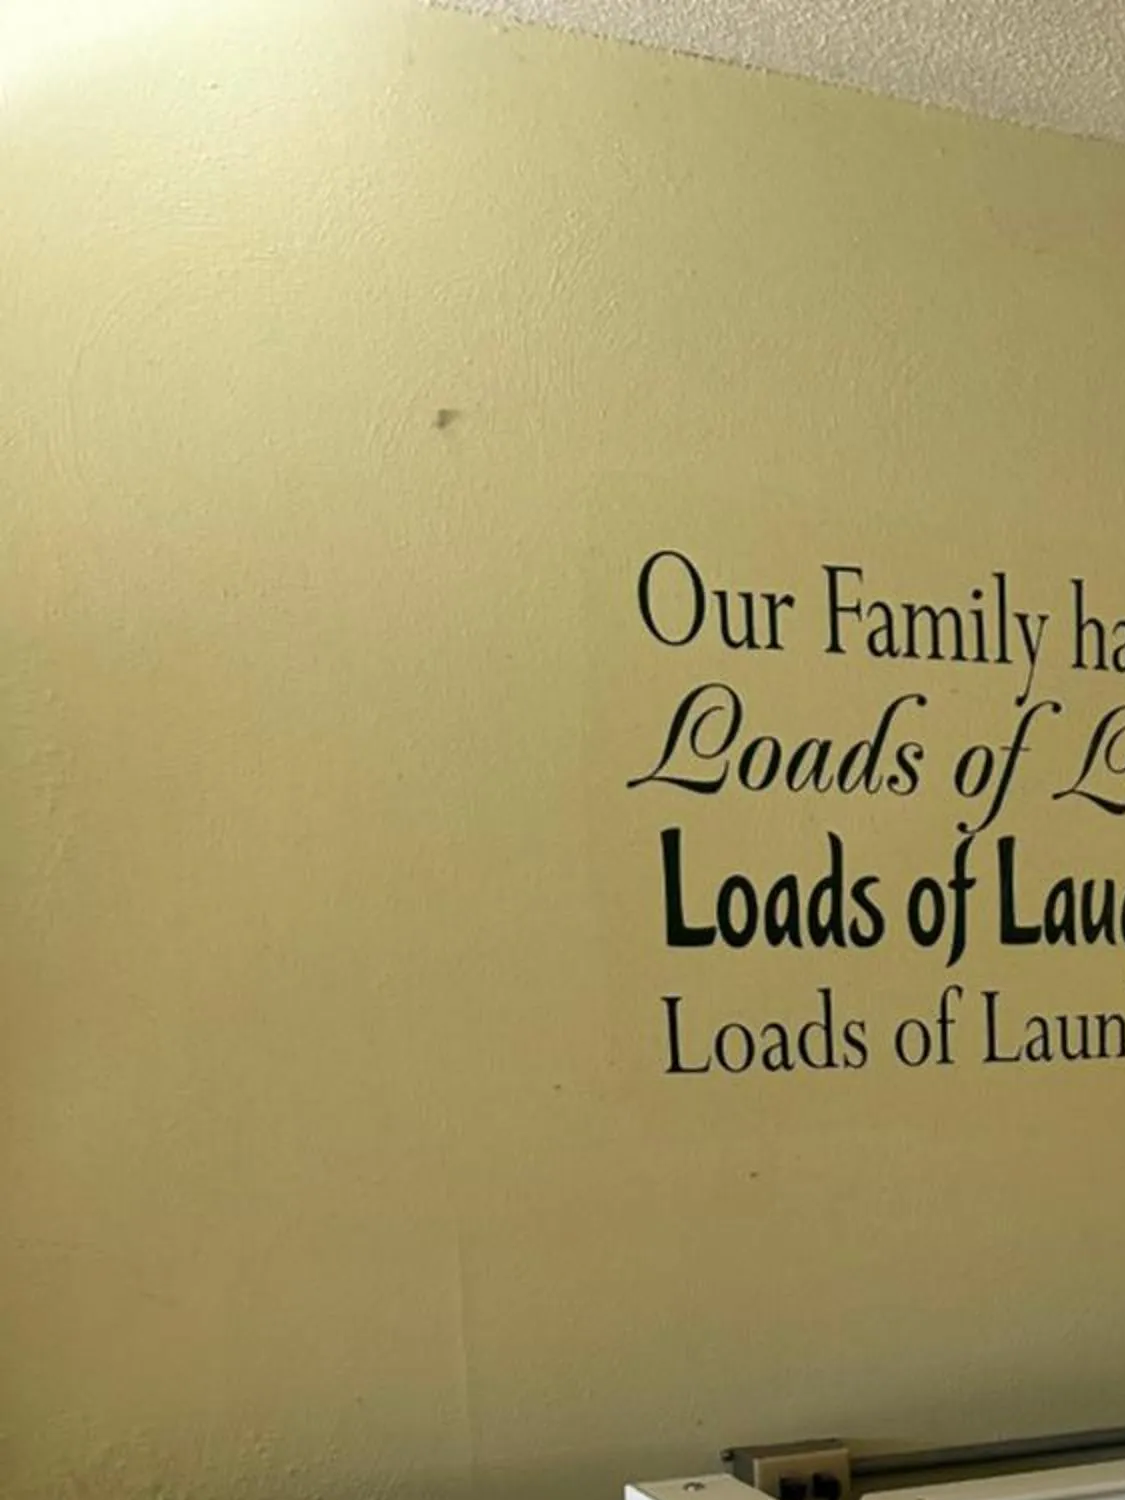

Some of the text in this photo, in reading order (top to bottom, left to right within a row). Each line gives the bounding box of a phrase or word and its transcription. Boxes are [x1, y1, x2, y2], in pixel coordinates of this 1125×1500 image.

[637, 550, 796, 648] Our
[822, 564, 1050, 708] Family
[626, 683, 927, 796] Loads
[953, 700, 1063, 835] of
[660, 827, 886, 950] Loads
[907, 834, 978, 968] of
[660, 987, 869, 1075] Loads
[894, 984, 965, 1068] of
